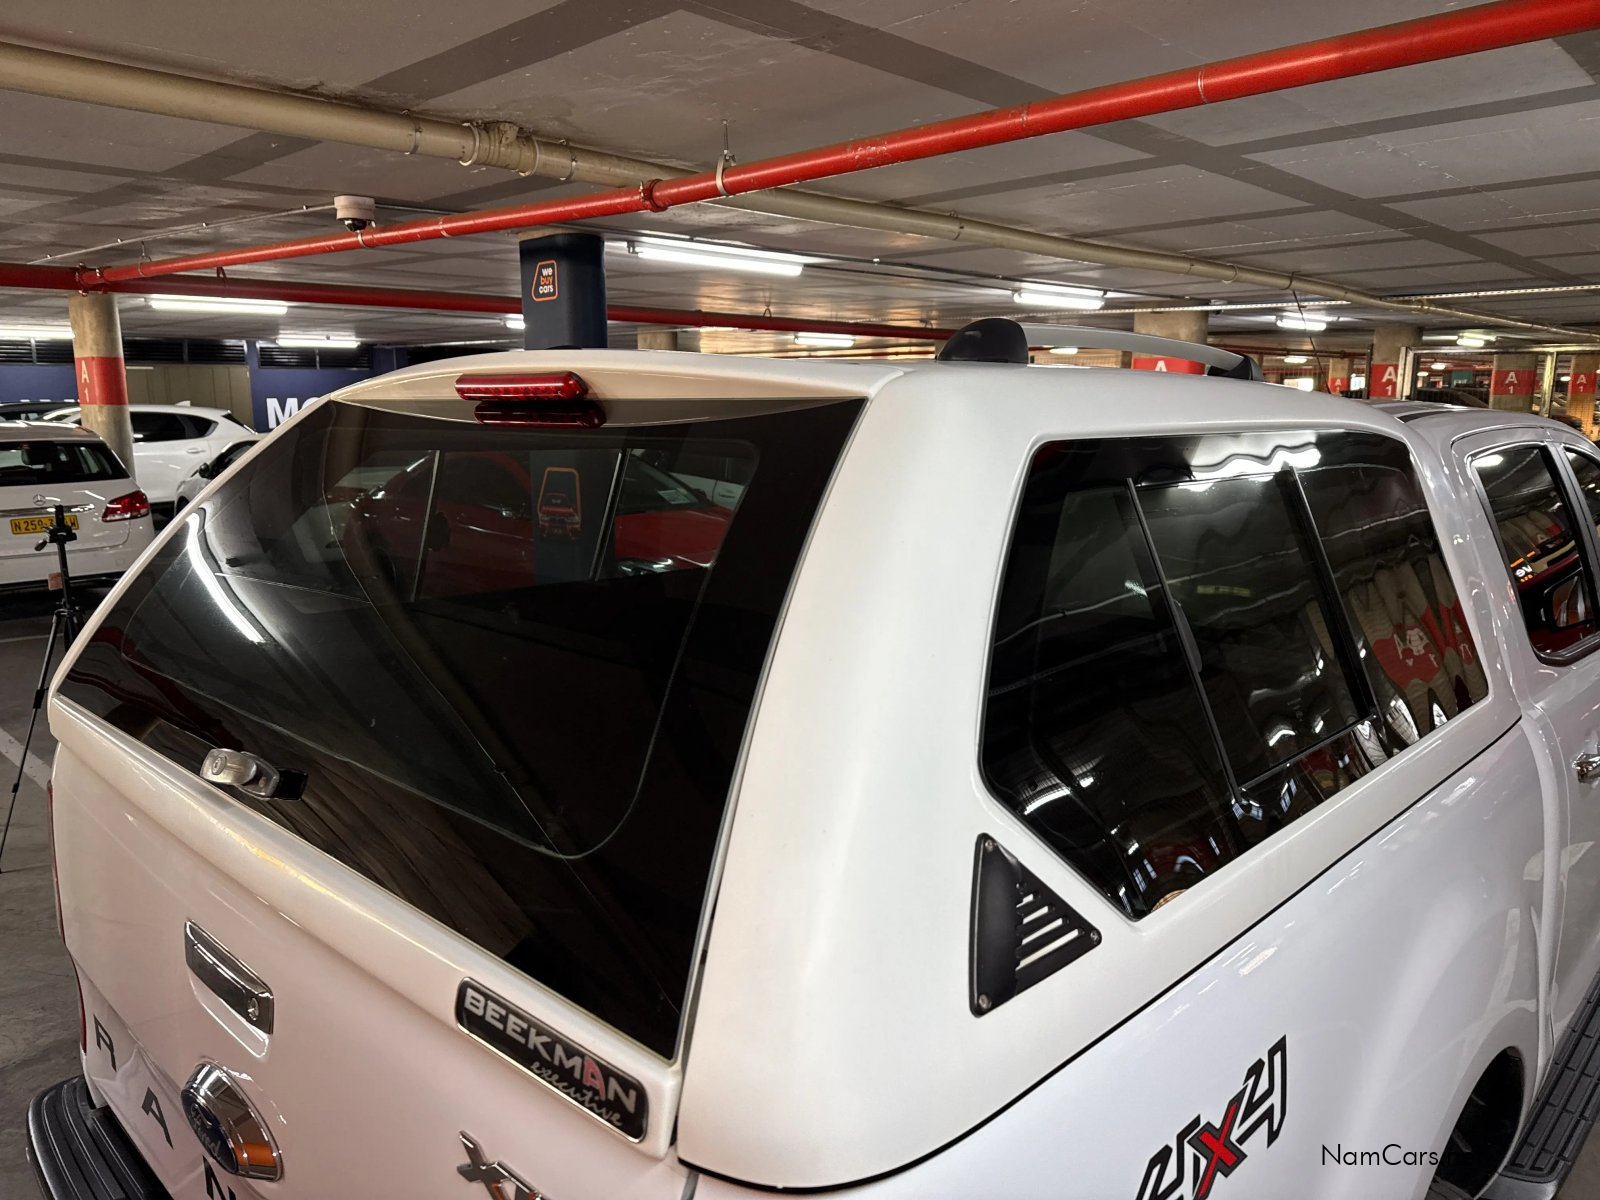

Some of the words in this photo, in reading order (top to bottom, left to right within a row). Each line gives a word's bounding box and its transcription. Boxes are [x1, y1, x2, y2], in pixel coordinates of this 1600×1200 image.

[542, 267, 553, 276] we
[541, 276, 553, 285] buy
[539, 285, 553, 294] cars
[81, 359, 89, 383] A
[1154, 360, 1168, 372] A
[1381, 366, 1397, 382] A
[1505, 372, 1517, 384] A
[1576, 374, 1587, 384] A
[1335, 378, 1342, 386] A
[84, 387, 89, 403] 1
[1386, 385, 1391, 396] 1
[1508, 386, 1514, 394] 1
[14, 521, 22, 532] N
[463, 987, 637, 1115] BEEKMAN
[530, 1061, 624, 1127] executive
